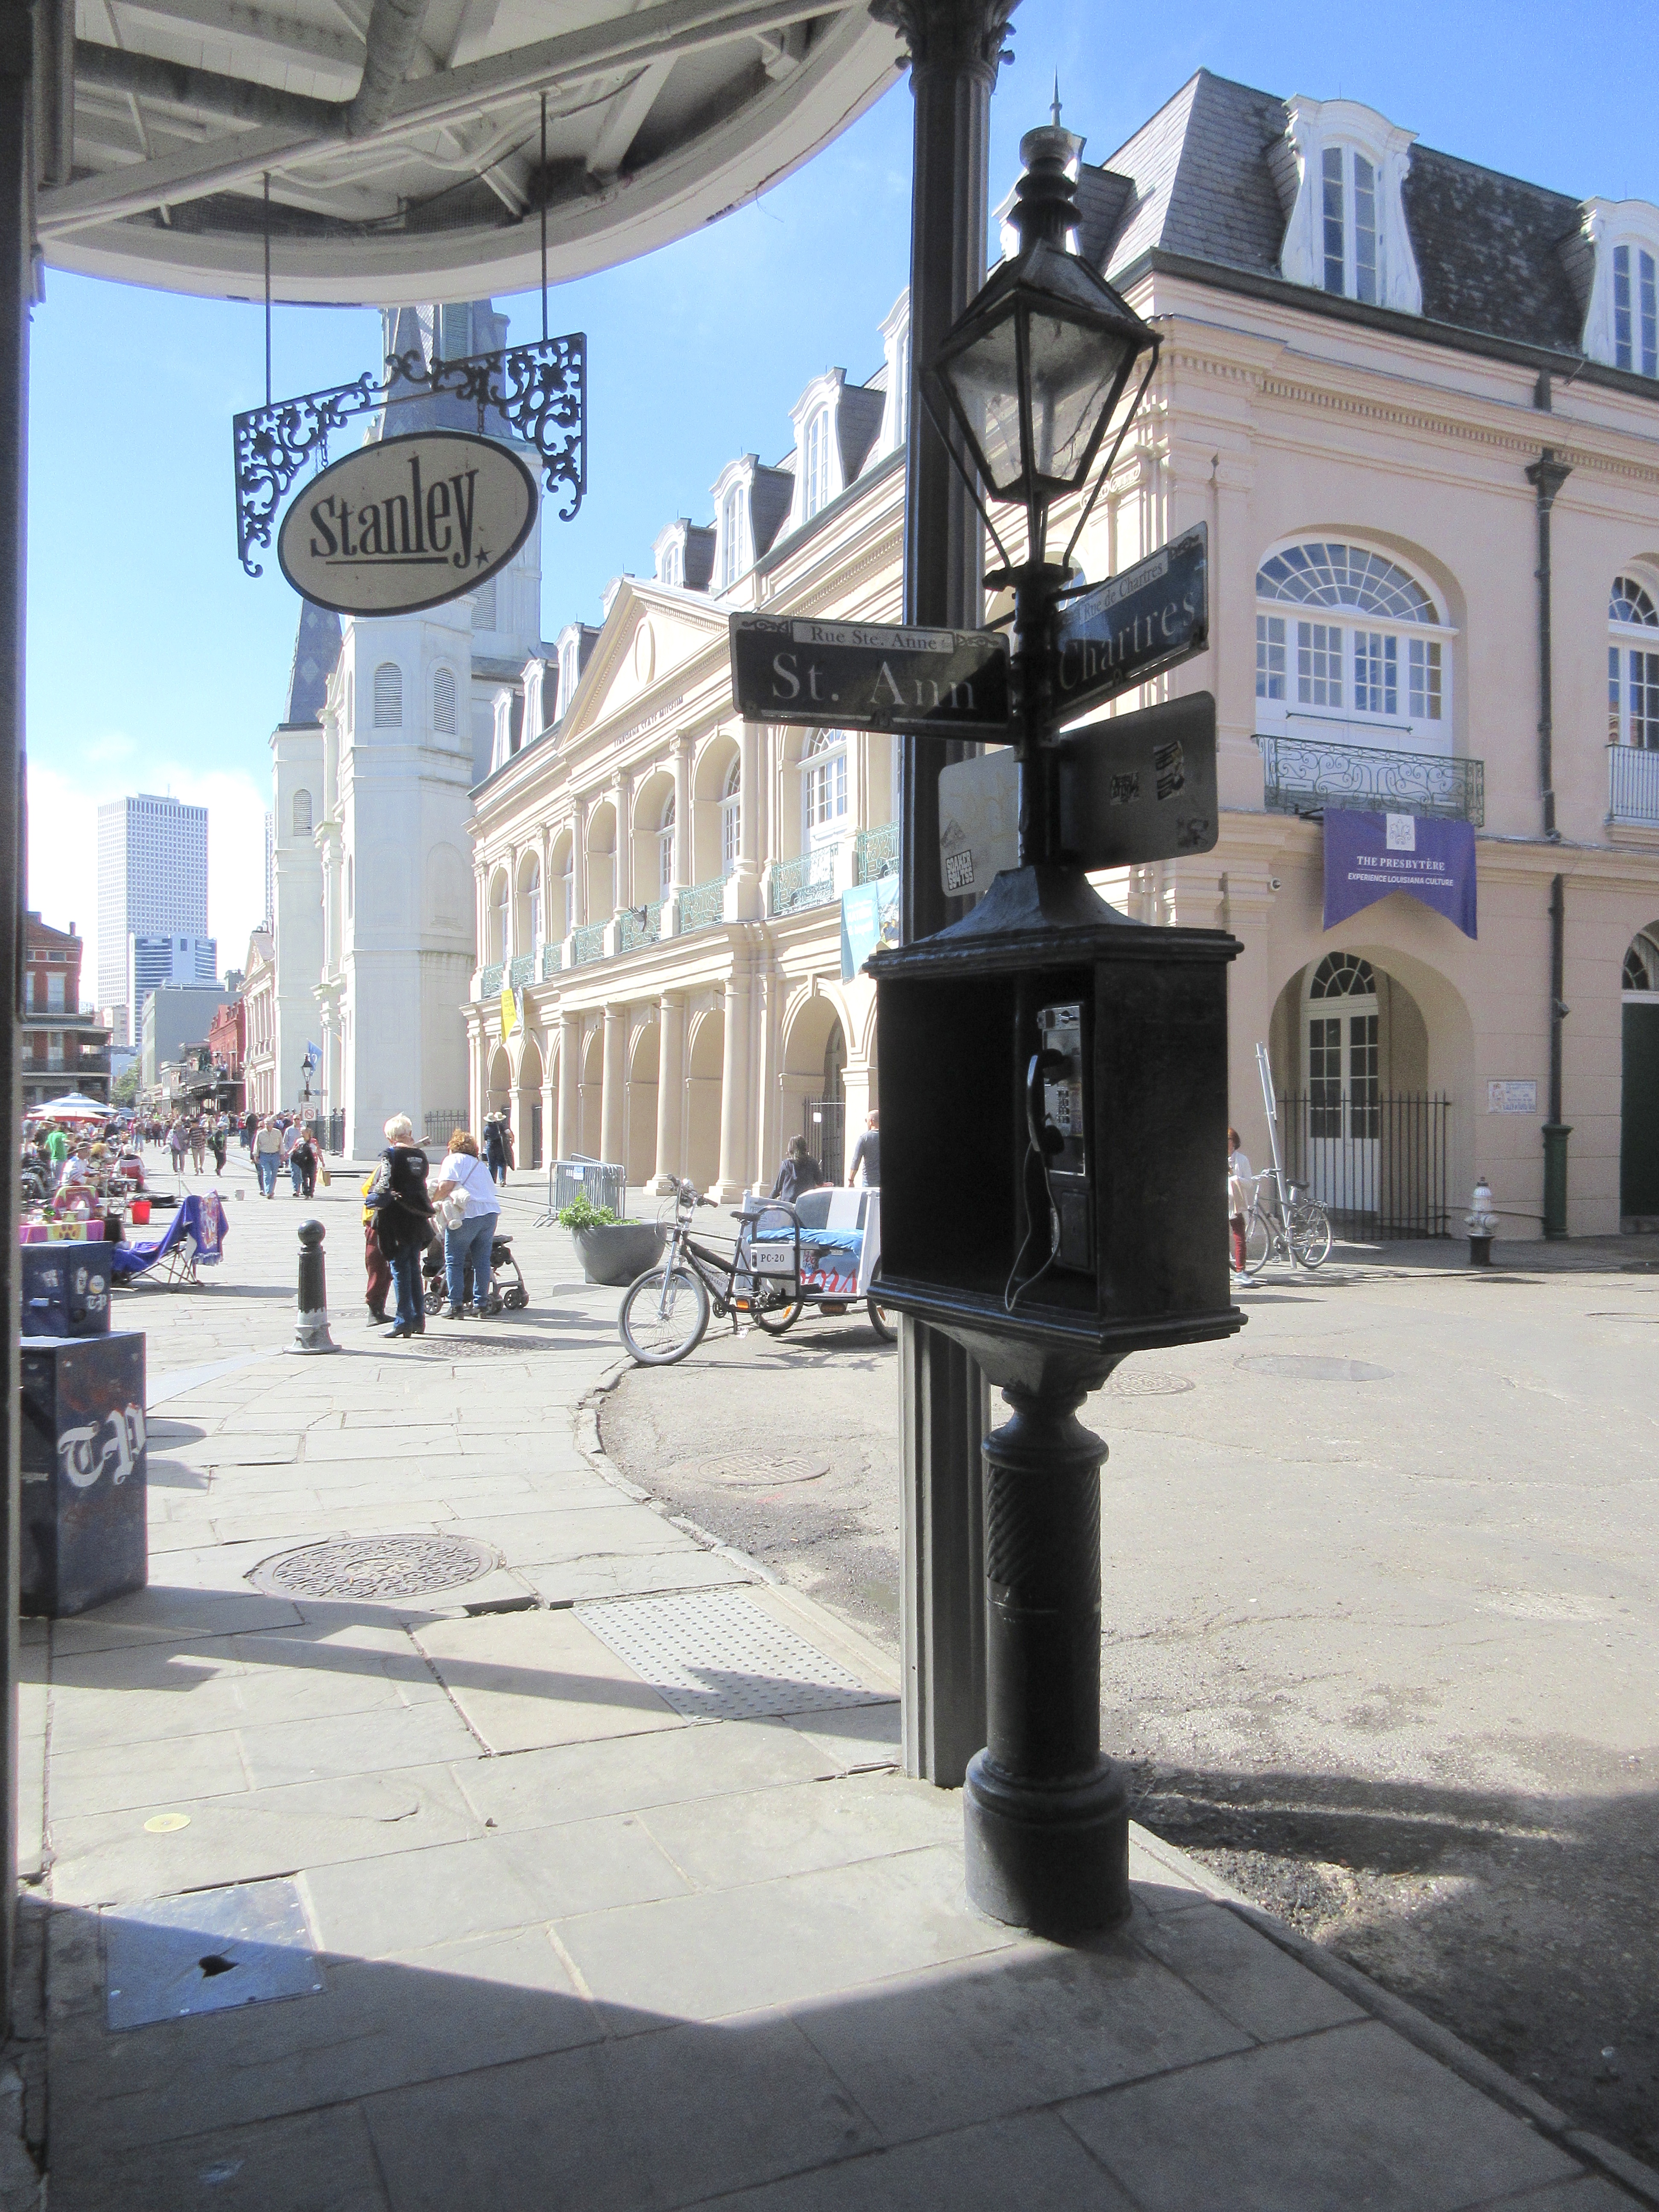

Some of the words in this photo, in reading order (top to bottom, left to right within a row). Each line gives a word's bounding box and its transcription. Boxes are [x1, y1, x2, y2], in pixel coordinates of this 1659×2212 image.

[311, 455, 479, 568] Stanley
[1084, 601, 1102, 619] Rue
[1105, 589, 1117, 607] de
[1120, 562, 1163, 597] Chartres
[811, 626, 844, 644] Rue
[853, 630, 884, 646] Ste.
[892, 633, 937, 650] Anne
[1059, 591, 1196, 690] Chartres
[772, 653, 839, 701] St.
[868, 661, 976, 709] Ann
[1348, 873, 1387, 883] EXPERIENCE
[1388, 875, 1424, 885] LOUISIANA
[1425, 877, 1453, 886] CULTURE
[1357, 856, 1378, 867] THE
[1379, 858, 1445, 871] PRESBYTÈRE
[760, 1254, 785, 1263] PC-20
